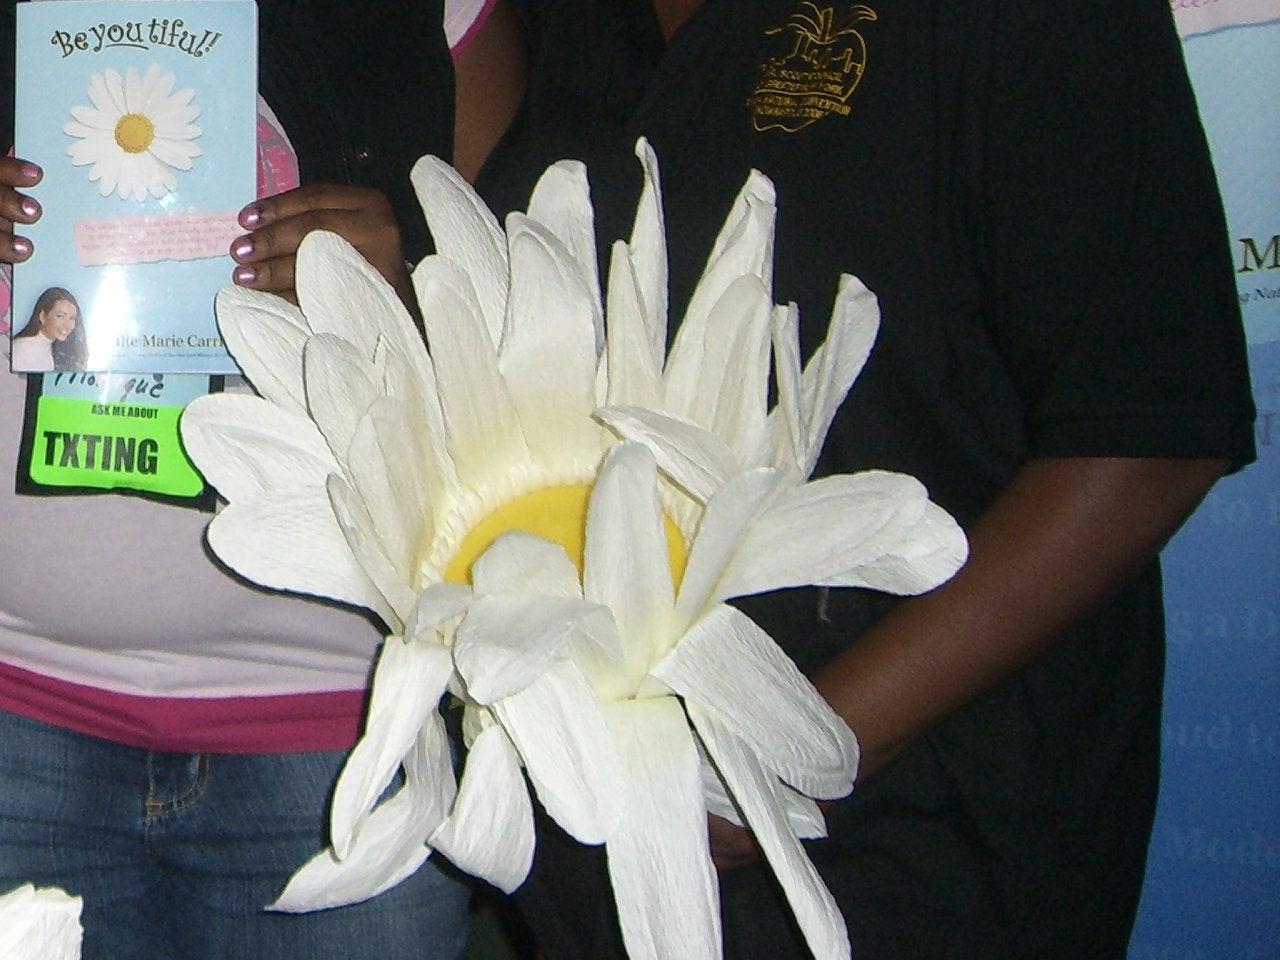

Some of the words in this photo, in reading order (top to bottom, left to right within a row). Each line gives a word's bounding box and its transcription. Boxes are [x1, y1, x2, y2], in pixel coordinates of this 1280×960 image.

[143, 334, 184, 348] Marie
[91, 404, 110, 416] ASK
[112, 405, 126, 417] ME
[127, 407, 159, 419] ABOUT
[43, 430, 159, 475] TXTING
